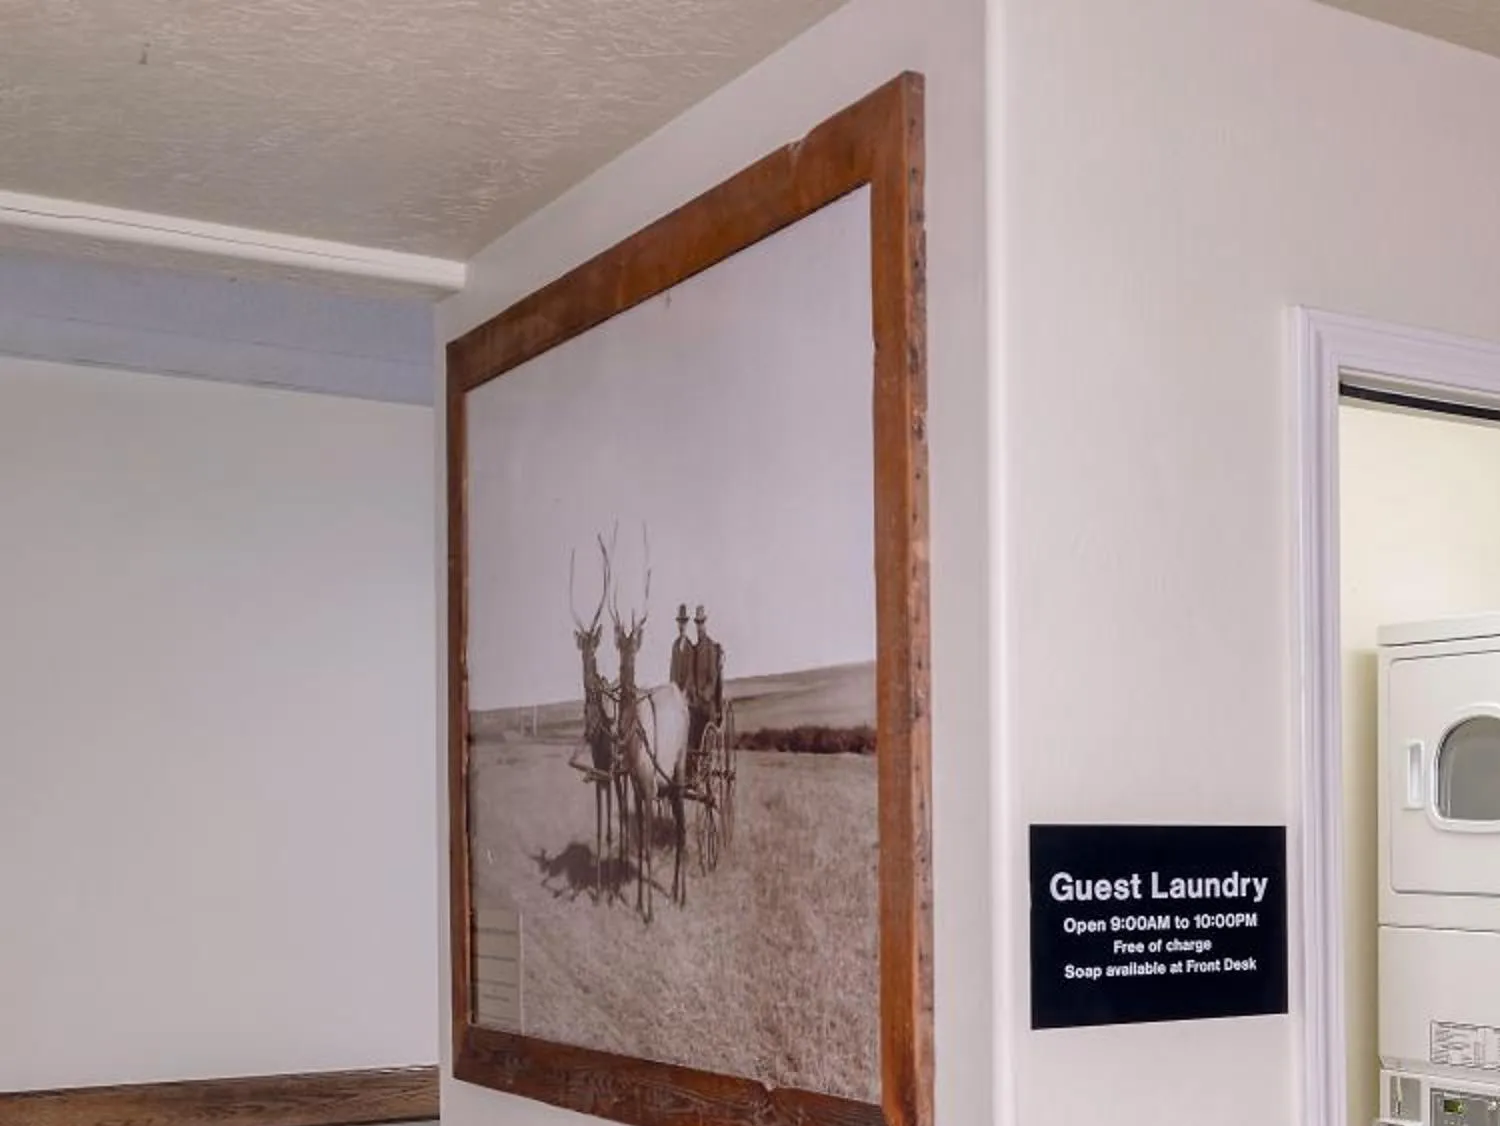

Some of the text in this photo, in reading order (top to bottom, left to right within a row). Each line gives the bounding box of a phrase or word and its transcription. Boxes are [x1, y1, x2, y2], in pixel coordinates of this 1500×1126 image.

[1049, 870, 1269, 903] Guest Laundry
[1063, 912, 1258, 935] Open 9:00AM to 10:00PM
[1113, 938, 1212, 954] Free of charge
[1064, 956, 1258, 980] Soap available at Front Desk
